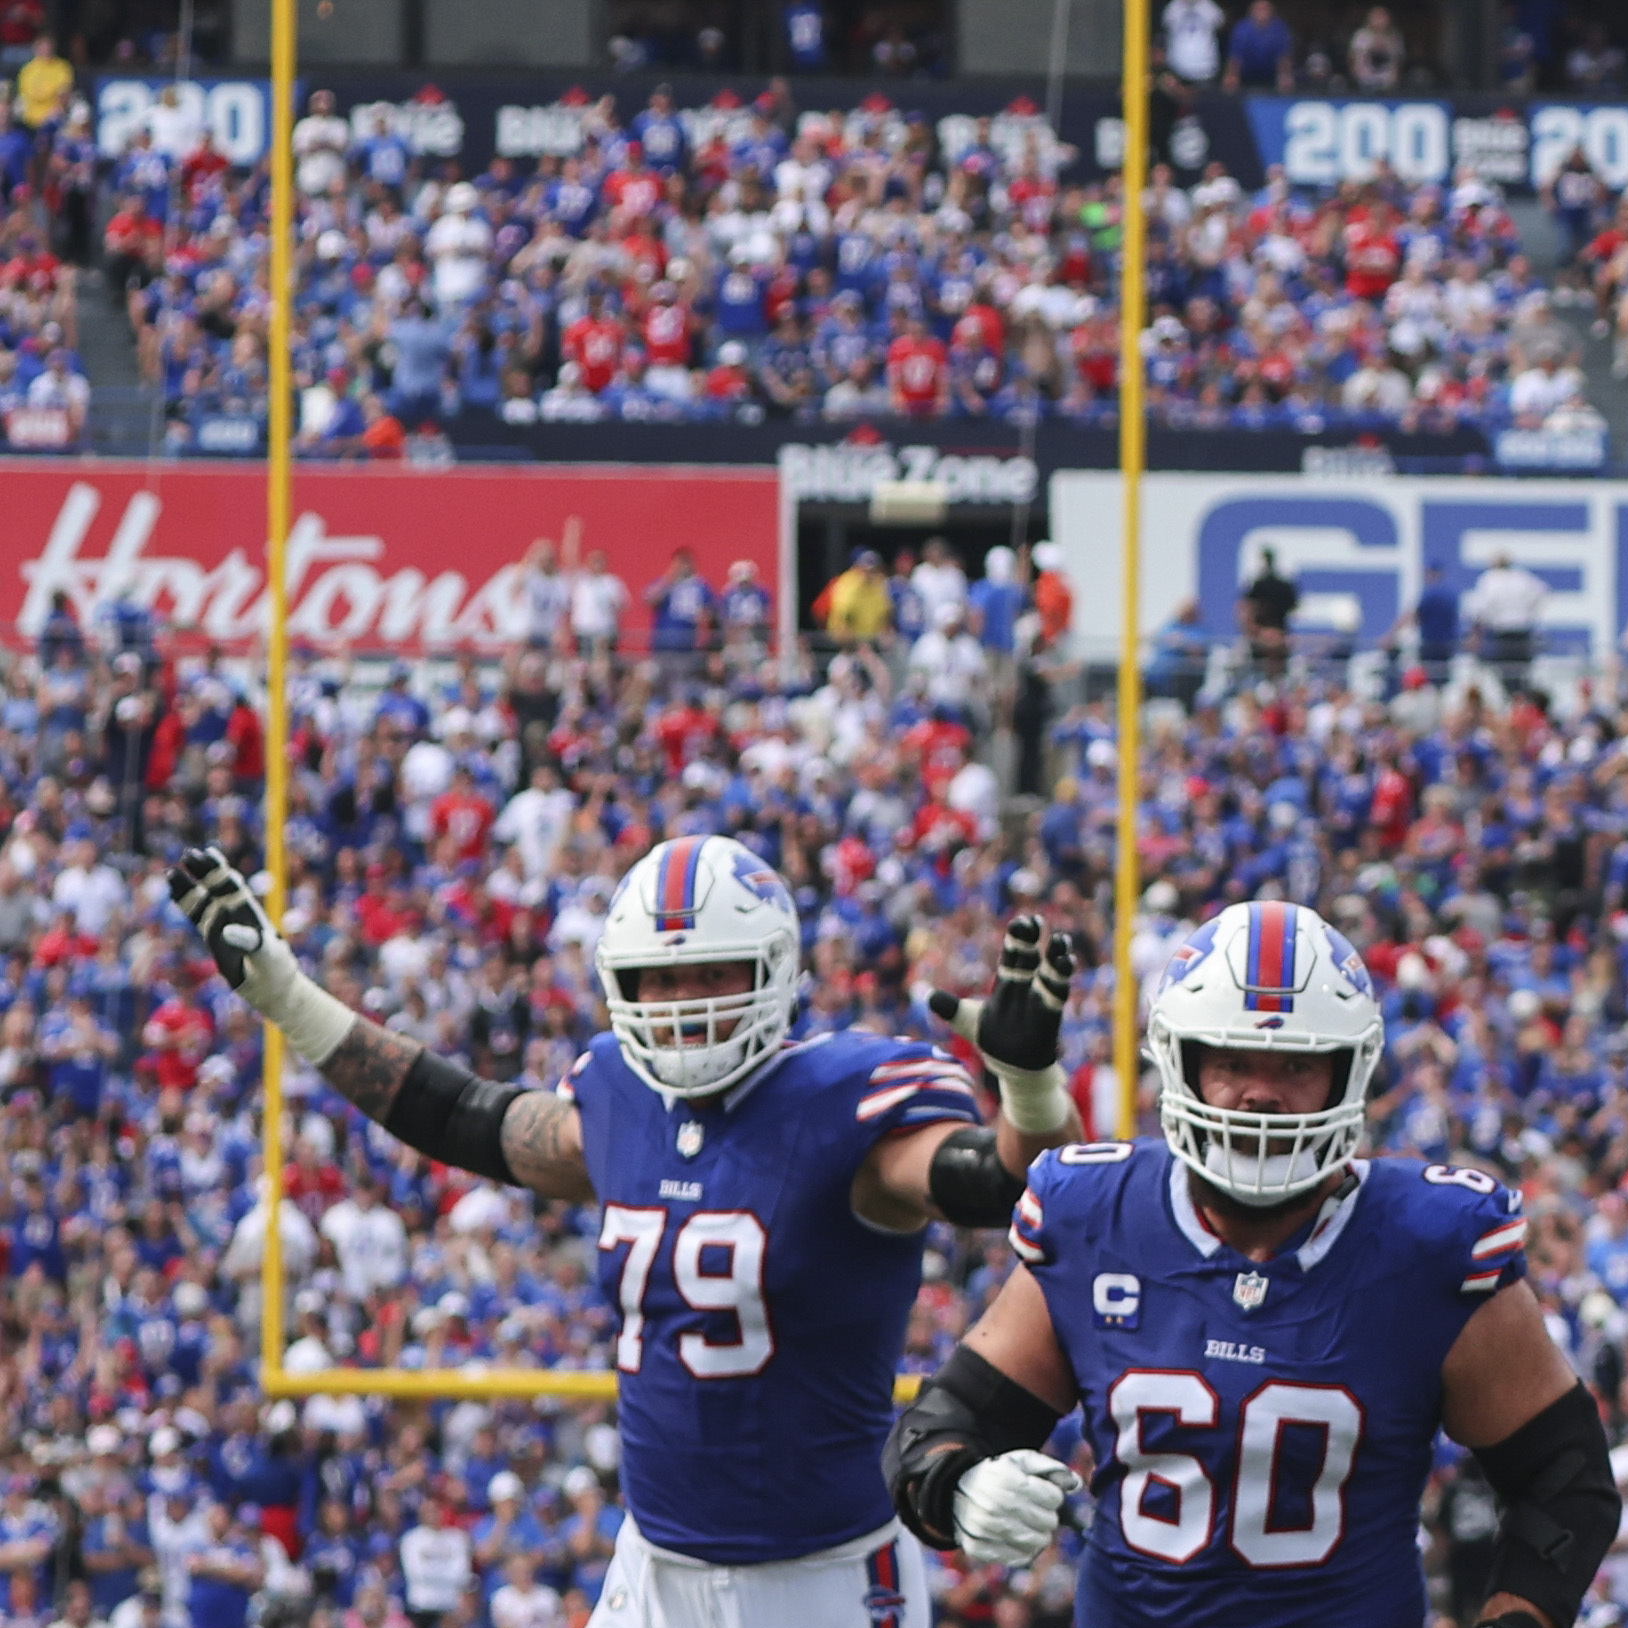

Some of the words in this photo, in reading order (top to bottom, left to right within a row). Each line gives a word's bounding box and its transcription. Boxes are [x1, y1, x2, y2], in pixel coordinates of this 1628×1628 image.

[1284, 102, 1449, 185] 200
[658, 1179, 703, 1201] BILLS
[599, 1202, 776, 1379] 79
[1093, 1272, 1141, 1316] C
[1204, 1339, 1265, 1364] BILLS
[1107, 1367, 1367, 1569] 60
